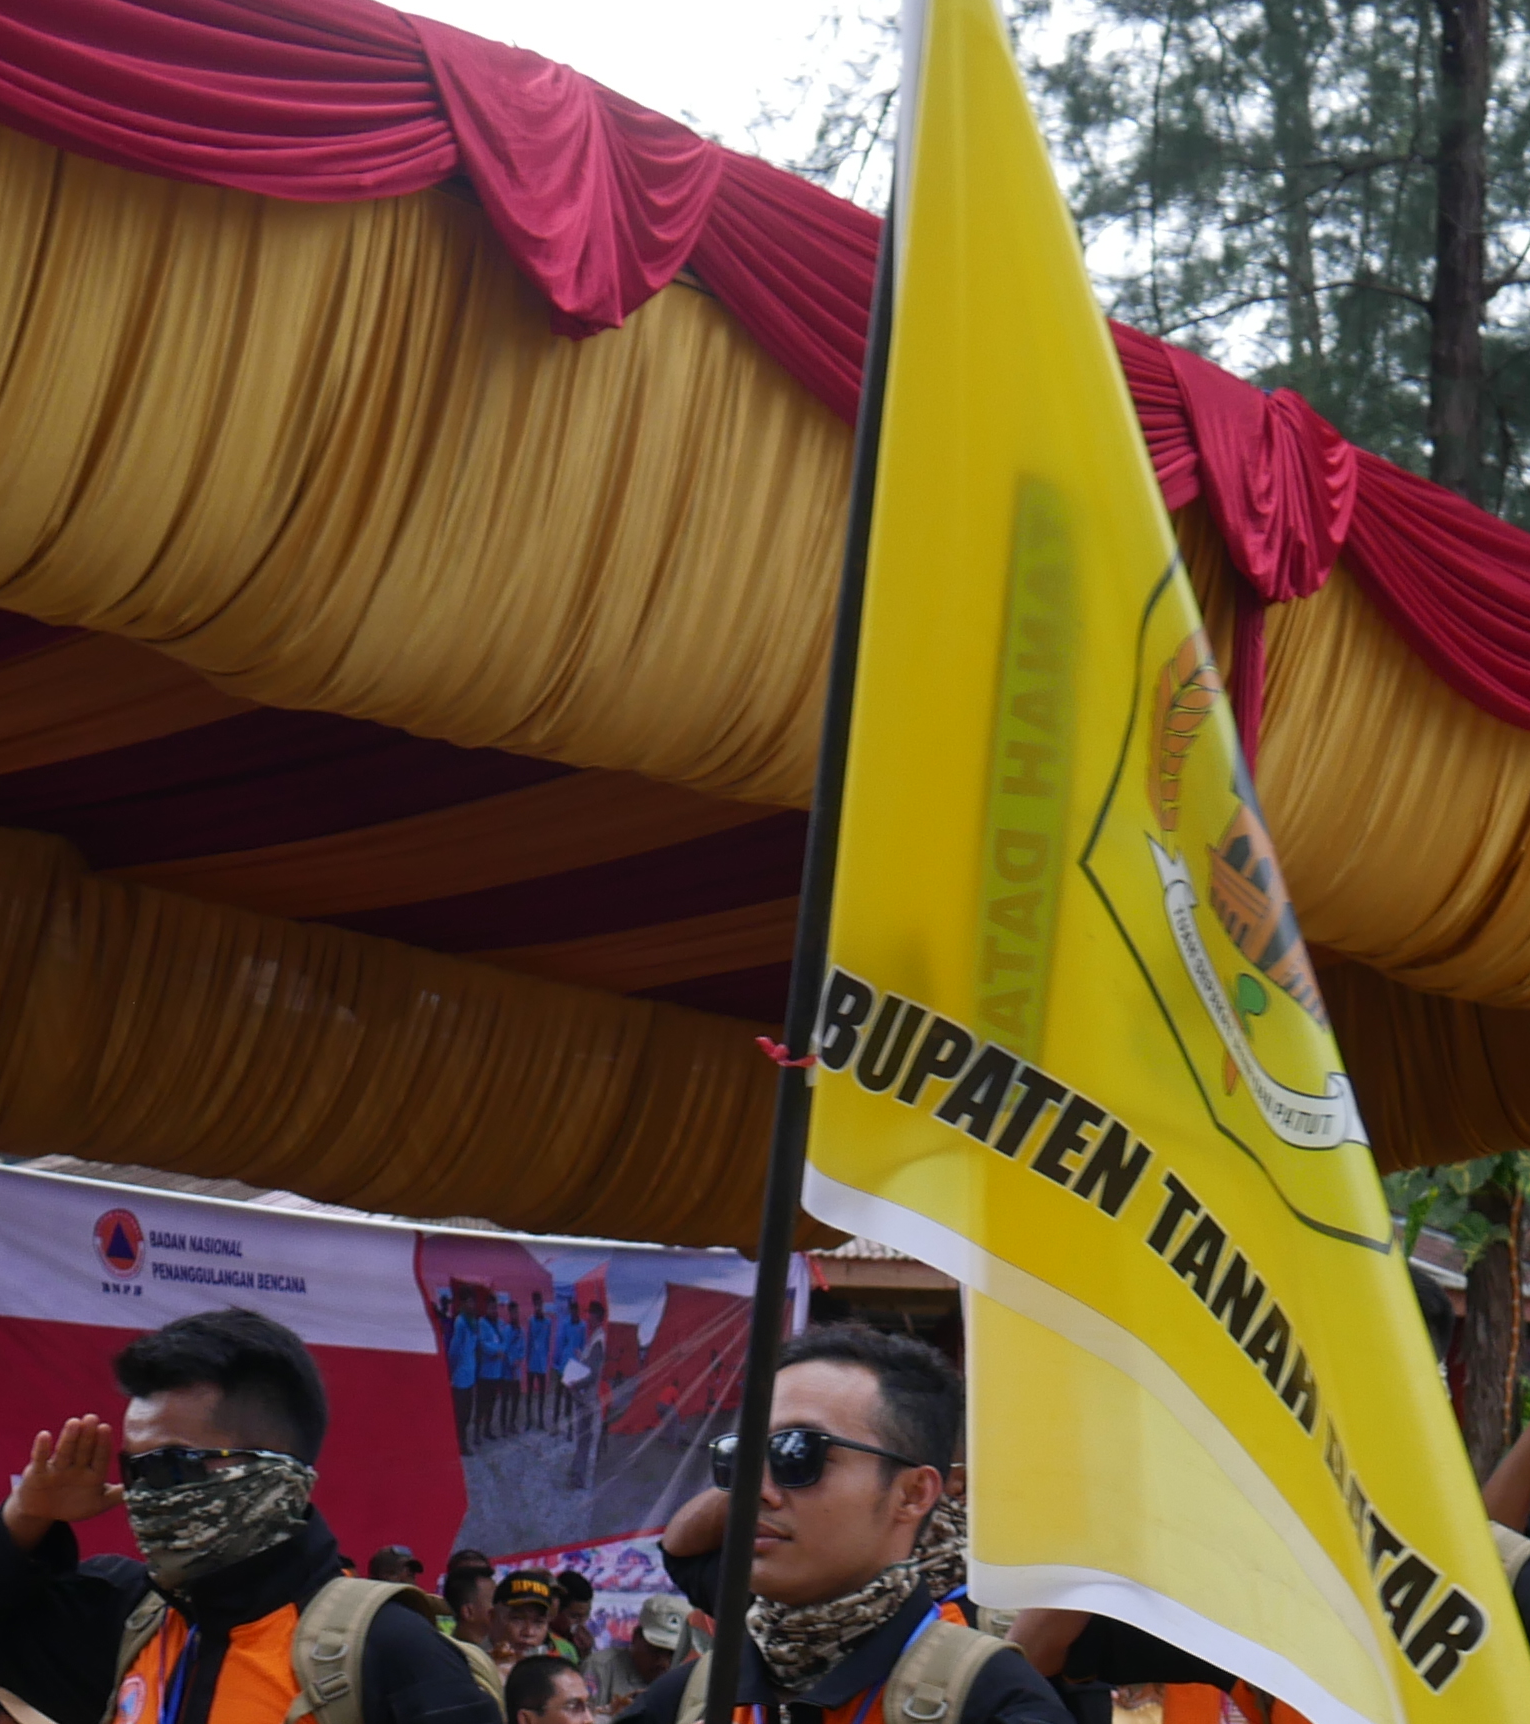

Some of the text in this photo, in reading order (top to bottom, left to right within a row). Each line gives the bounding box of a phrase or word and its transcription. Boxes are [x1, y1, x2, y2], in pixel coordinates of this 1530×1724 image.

[149, 1230, 244, 1258] BADAN NASIONAL
[152, 1262, 307, 1294] PENANGGULANGAN BENCANA
[1143, 1168, 1322, 1437] TANAH
